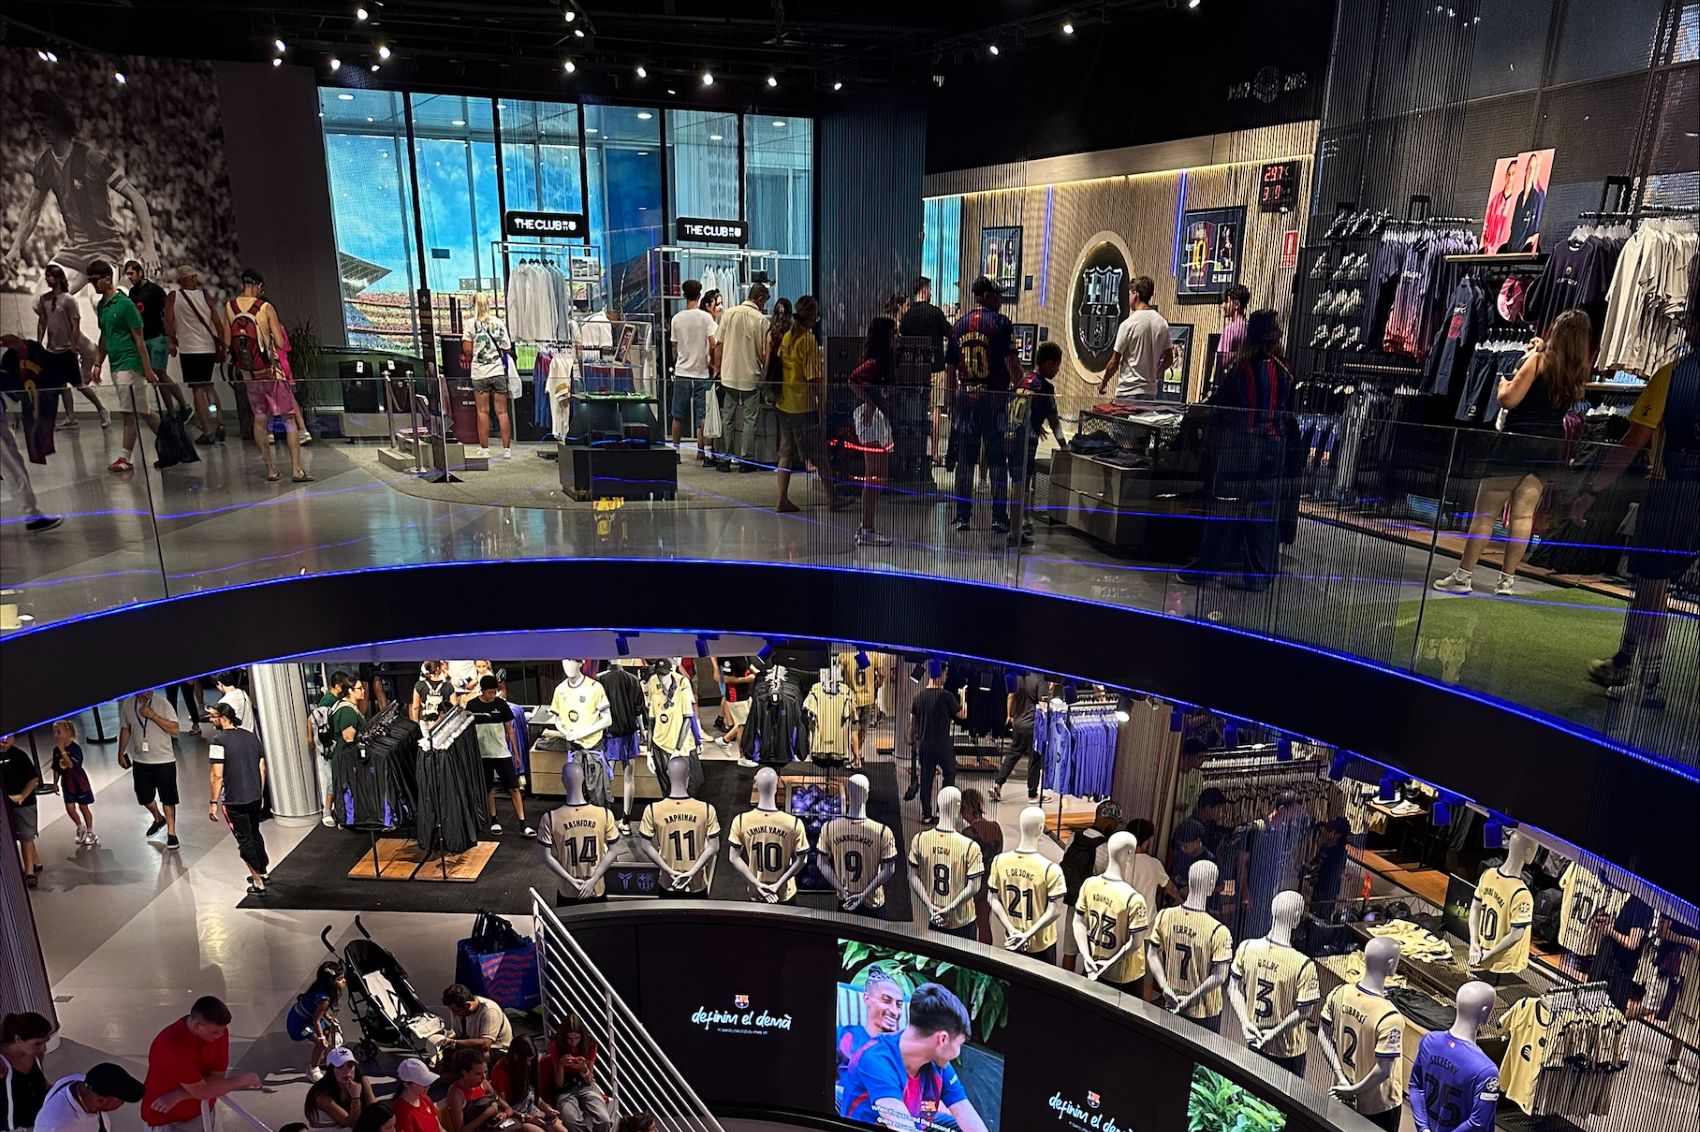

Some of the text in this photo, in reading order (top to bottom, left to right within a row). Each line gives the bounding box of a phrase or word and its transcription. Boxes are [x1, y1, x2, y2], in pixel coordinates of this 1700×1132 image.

[514, 219, 534, 230] THE
[535, 219, 562, 231] CLUB
[684, 225, 703, 236] THE
[703, 225, 728, 237] CLUB
[961, 345, 989, 378] 10
[563, 819, 597, 831] RASHFORD
[664, 814, 698, 825] RAPHINHA
[747, 826, 789, 840] LAMINE YAMAL
[565, 836, 598, 868] 14
[669, 829, 696, 861] 11
[751, 842, 783, 873] 10
[844, 851, 862, 883] 9
[933, 864, 950, 897] 8
[1006, 884, 1033, 921] 21
[1089, 909, 1117, 949] 23
[1480, 904, 1498, 941] 10
[1175, 943, 1192, 980] 7
[1255, 977, 1275, 1022] 3
[1341, 1004, 1368, 1025] CUBARSÍ
[691, 1005, 792, 1031] definim el demà
[1342, 1025, 1358, 1071] 2
[1048, 1091, 1089, 1124] definim
[1090, 1113, 1103, 1129] el
[1424, 1072, 1463, 1128] 25
